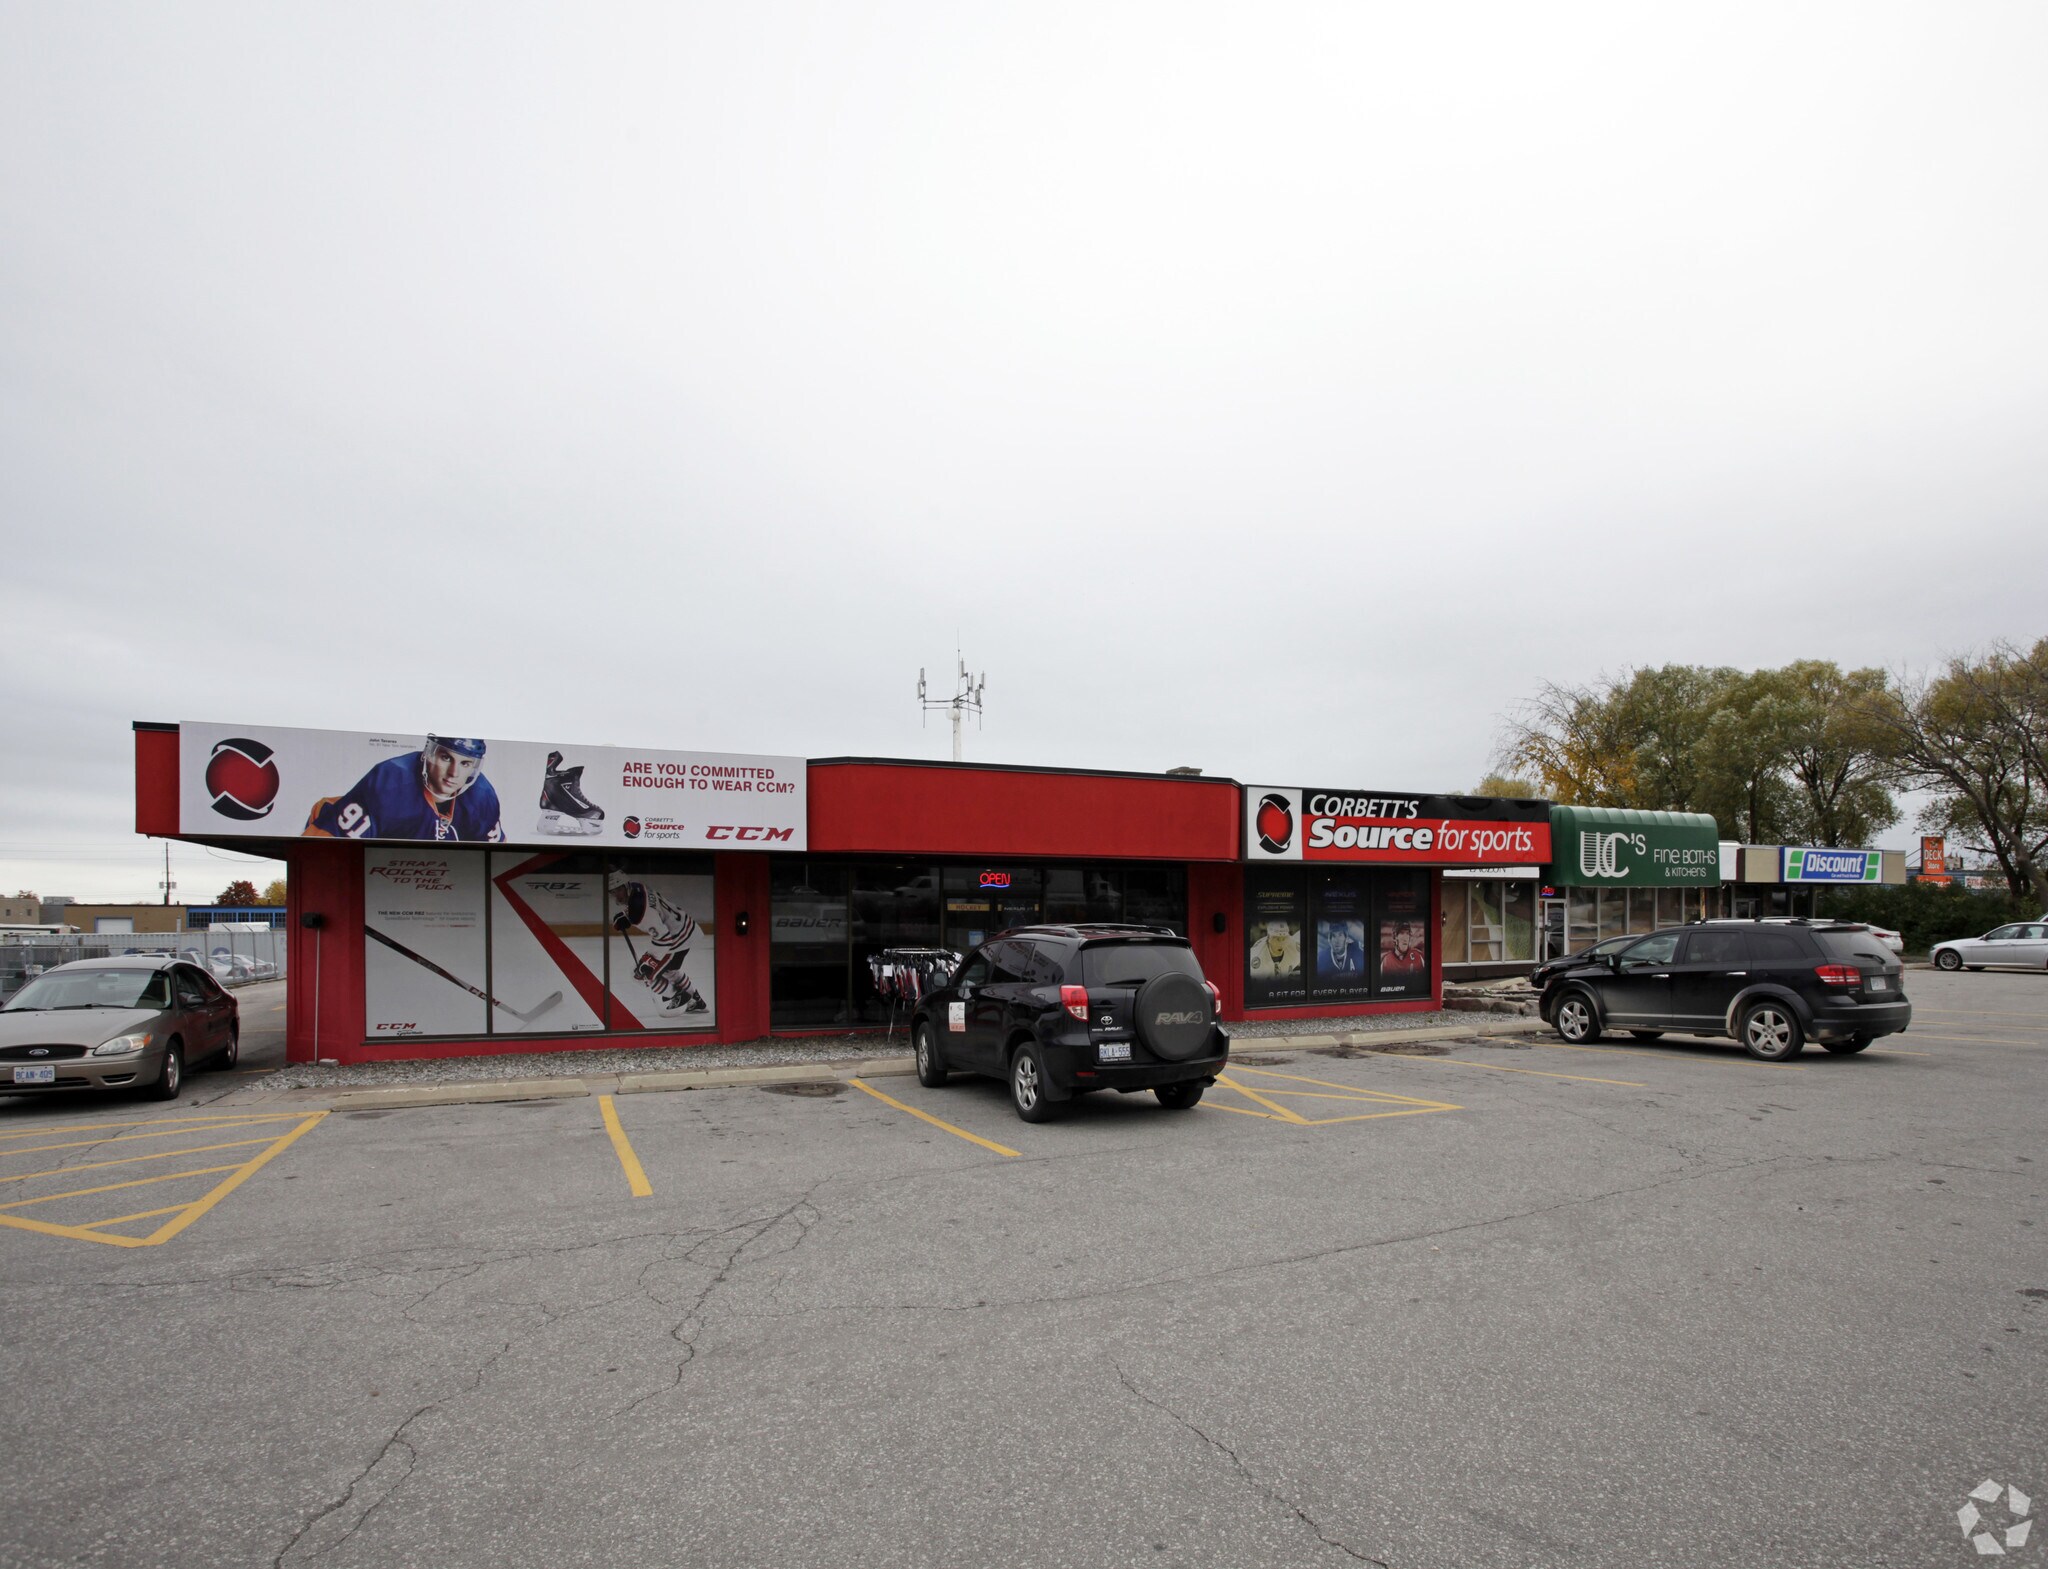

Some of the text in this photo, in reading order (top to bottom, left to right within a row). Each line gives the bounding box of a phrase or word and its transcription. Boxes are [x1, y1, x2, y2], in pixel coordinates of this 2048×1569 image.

[623, 762, 775, 780] ARE YOU COMMITTED
[623, 776, 795, 793] ENOUGH TO WEAR CCM?
[1308, 794, 1419, 819] CORBETT'S
[338, 803, 371, 838] 91
[644, 822, 684, 831] Source
[644, 831, 655, 839] for
[705, 825, 795, 842] CCM
[1308, 818, 1434, 851] Source
[1437, 820, 1463, 850] for
[1924, 849, 1942, 860] DECK
[1806, 854, 1863, 872] Discount
[369, 867, 451, 879] ROCKET
[979, 872, 1011, 885] OPEN
[1665, 867, 1670, 877] &
[526, 882, 582, 892] RBZ
[1410, 952, 1415, 960] C
[1155, 1011, 1204, 1026] RAV4
